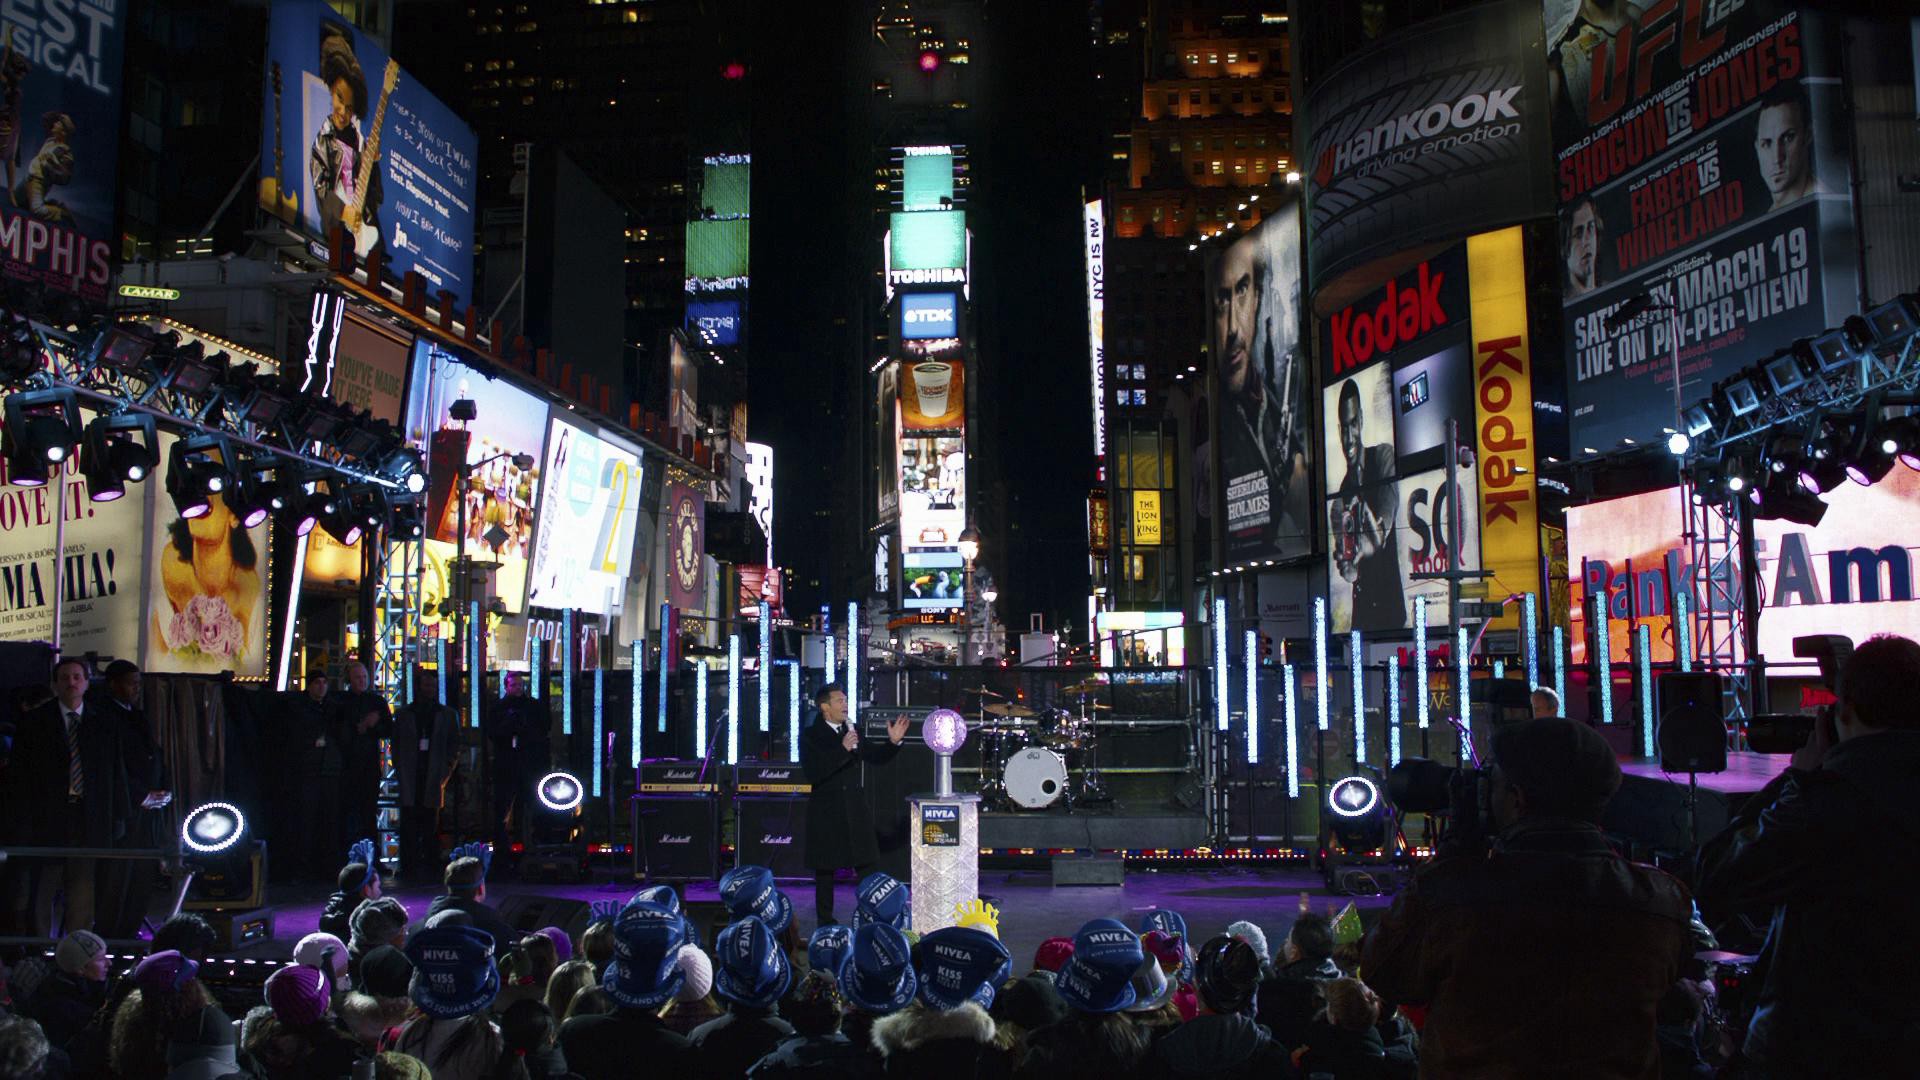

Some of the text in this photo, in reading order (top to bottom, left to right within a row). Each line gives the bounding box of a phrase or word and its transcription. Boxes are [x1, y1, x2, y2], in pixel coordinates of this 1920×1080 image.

[1587, 0, 1730, 127] UFC
[1558, 10, 1798, 160] WORLD LIGHT HEAVYWEIGHT CHAMPIONSHIP
[1559, 22, 1803, 201] SHOGUN VS JONES
[904, 146, 952, 156] TOSHIBA
[1357, 121, 1522, 179] driving emotion
[425, 147, 445, 171] ROCK
[1629, 178, 1648, 193] PLUS
[1631, 156, 1720, 227] FABER VS
[1616, 179, 1746, 273] WINELAND
[1091, 243, 1101, 259] IS
[891, 268, 966, 284] TOSHIBA
[1676, 243, 1768, 314] MARCH
[1772, 226, 1809, 271] 19
[1092, 264, 1104, 300] NYC
[126, 287, 174, 299] LAMAR
[915, 309, 953, 323] TDK
[1330, 260, 1449, 376] Kodak
[1576, 268, 1810, 381] LIVE ON PAY-PER-VIEW
[1477, 335, 1530, 529] Kodak
[1227, 475, 1269, 501] SHERLOCK
[1139, 500, 1154, 509] THE
[1227, 494, 1271, 521] HOLMES
[1136, 511, 1157, 522] LION
[1136, 525, 1158, 537] KING
[1584, 547, 1695, 620] Bank
[663, 769, 697, 779] Marshall
[758, 769, 790, 780] Marshall
[925, 809, 956, 818] NIVEA
[760, 834, 793, 844] Marshall
[869, 878, 898, 905] NIVEA
[739, 919, 752, 958] NIVEA
[1089, 932, 1133, 944] NIVEA
[423, 950, 460, 961] NIVEA
[935, 944, 972, 961] NIVEA
[429, 973, 456, 984] KISS
[938, 965, 963, 980] KISS
